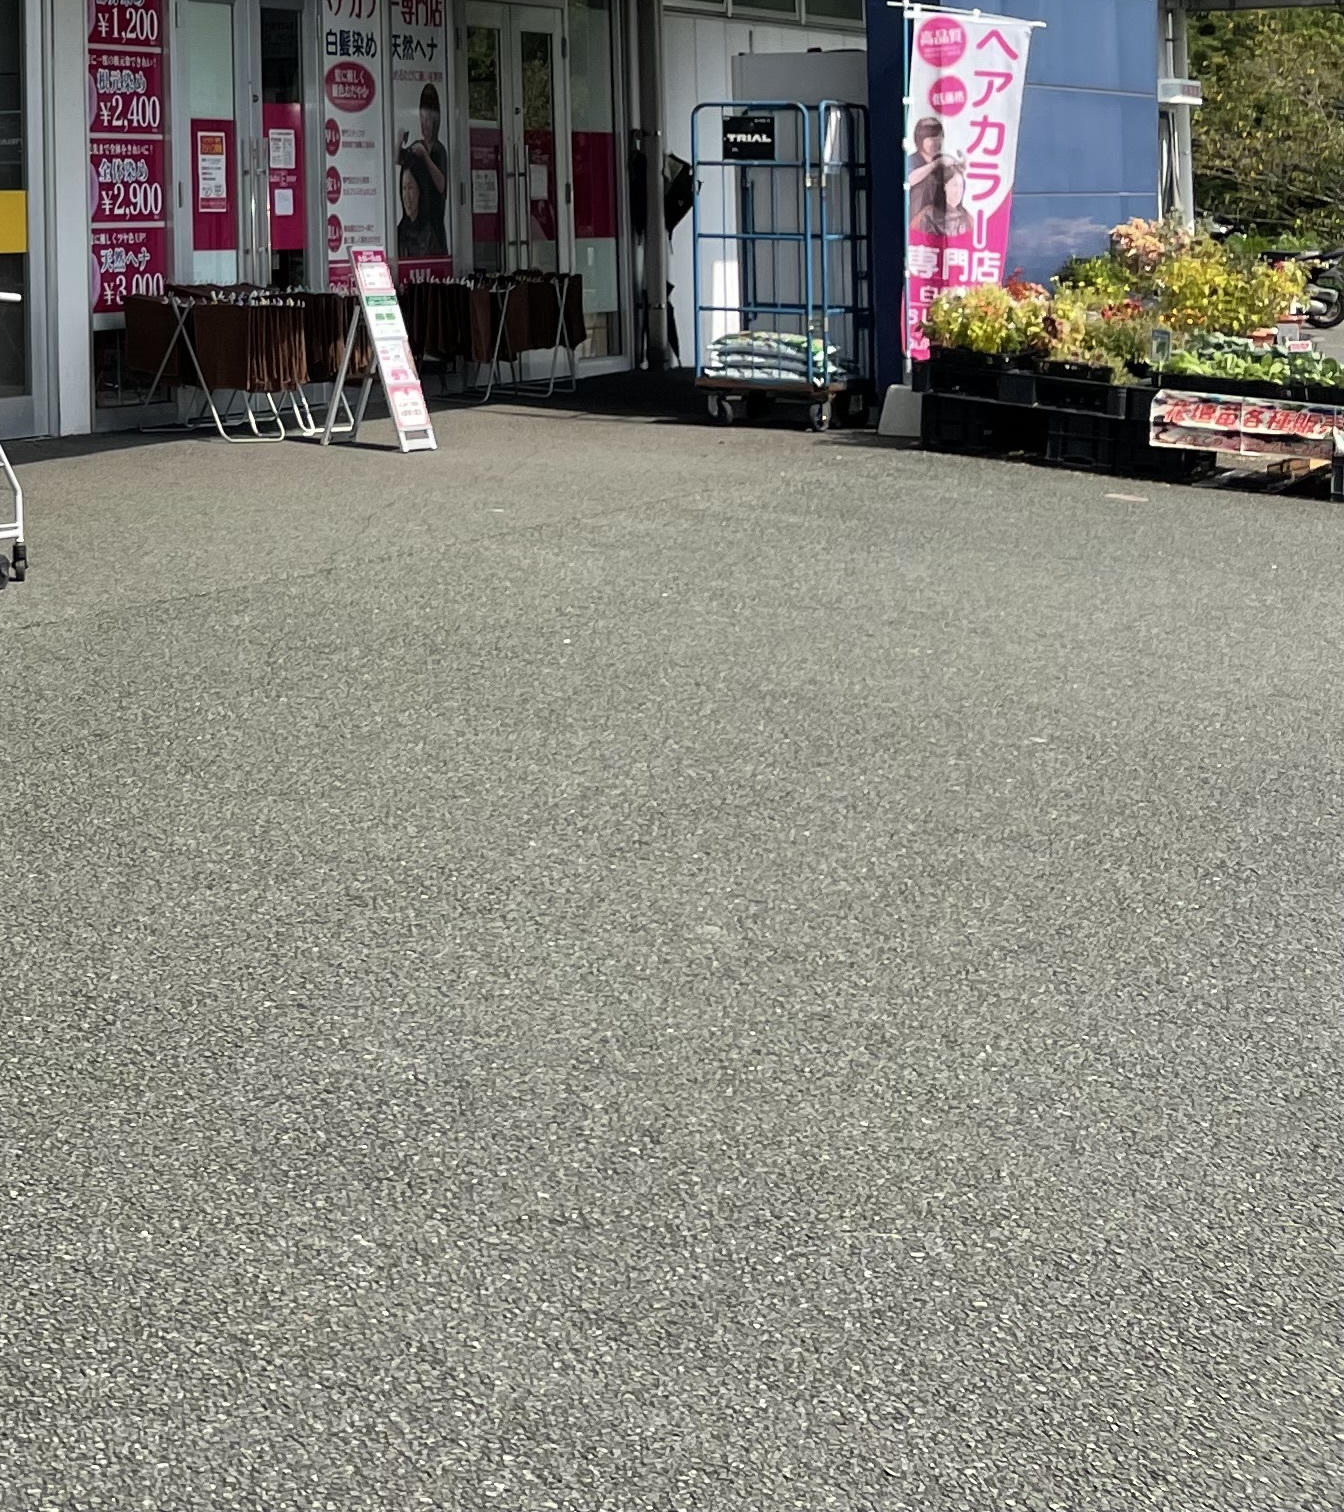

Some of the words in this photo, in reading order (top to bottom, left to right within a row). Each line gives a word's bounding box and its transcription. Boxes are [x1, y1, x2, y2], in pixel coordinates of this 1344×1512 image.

[97, 7, 159, 44] ¥1,200
[325, 29, 378, 59] 白髪染め
[391, 34, 438, 62] 天然ヘナ
[99, 94, 161, 132] ¥2,400
[726, 133, 772, 143] TRIAL
[966, 29, 1019, 245] ヘアカラー
[101, 182, 163, 220] ¥2,900
[908, 244, 1002, 283] 専門店
[103, 272, 165, 306] ¥3000
